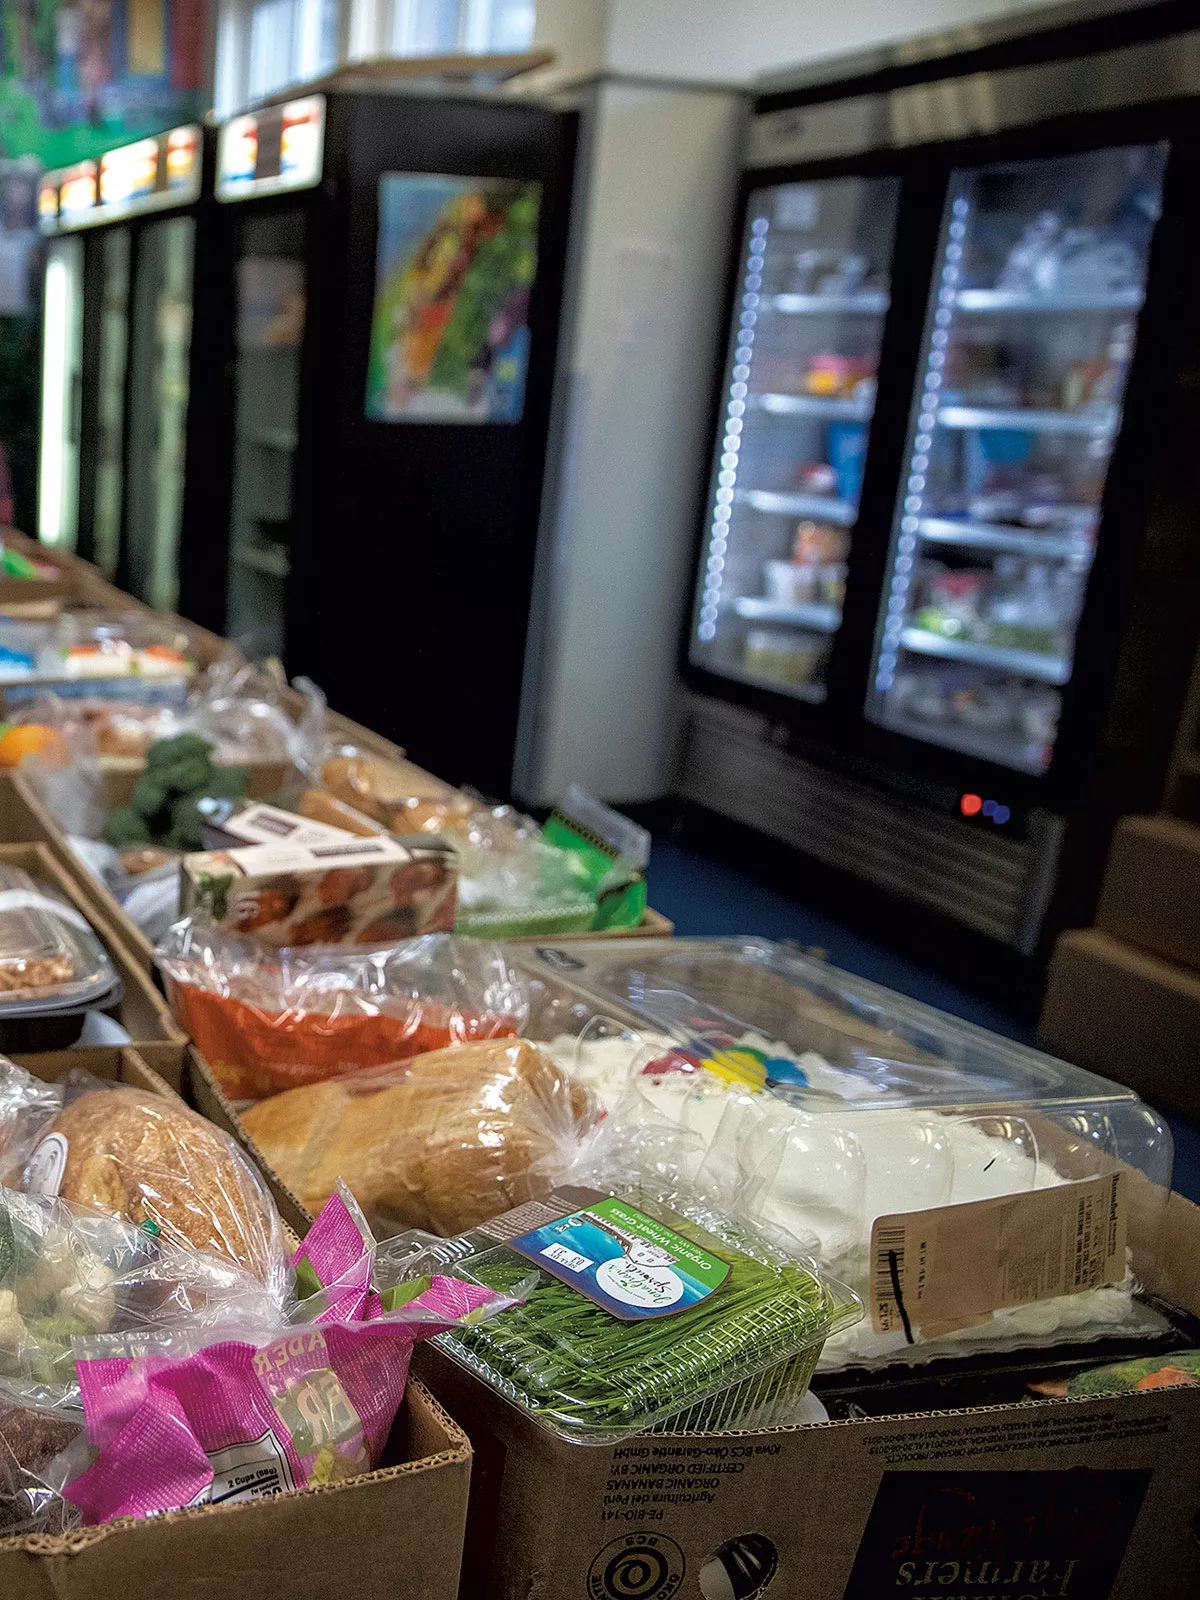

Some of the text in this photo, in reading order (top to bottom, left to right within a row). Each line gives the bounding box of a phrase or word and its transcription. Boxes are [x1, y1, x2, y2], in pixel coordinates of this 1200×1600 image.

[609, 1206, 712, 1271] Organic Wheat Grass
[608, 1263, 673, 1304] Jonathan's
[625, 1263, 673, 1295] Sprouts
[612, 1447, 649, 1459] GmbH
[730, 1446, 752, 1456] BCS
[929, 1449, 966, 1459] ORGANIC
[609, 1463, 744, 1474] CERTIFIED ORGANIC BY:
[227, 1479, 234, 1488] 2
[234, 1472, 254, 1485] Cups
[605, 1478, 719, 1489] ORGANIC BANANAS
[630, 1494, 649, 1504] del
[652, 1491, 714, 1503] Agricultura
[894, 1558, 1080, 1596] Farmers
